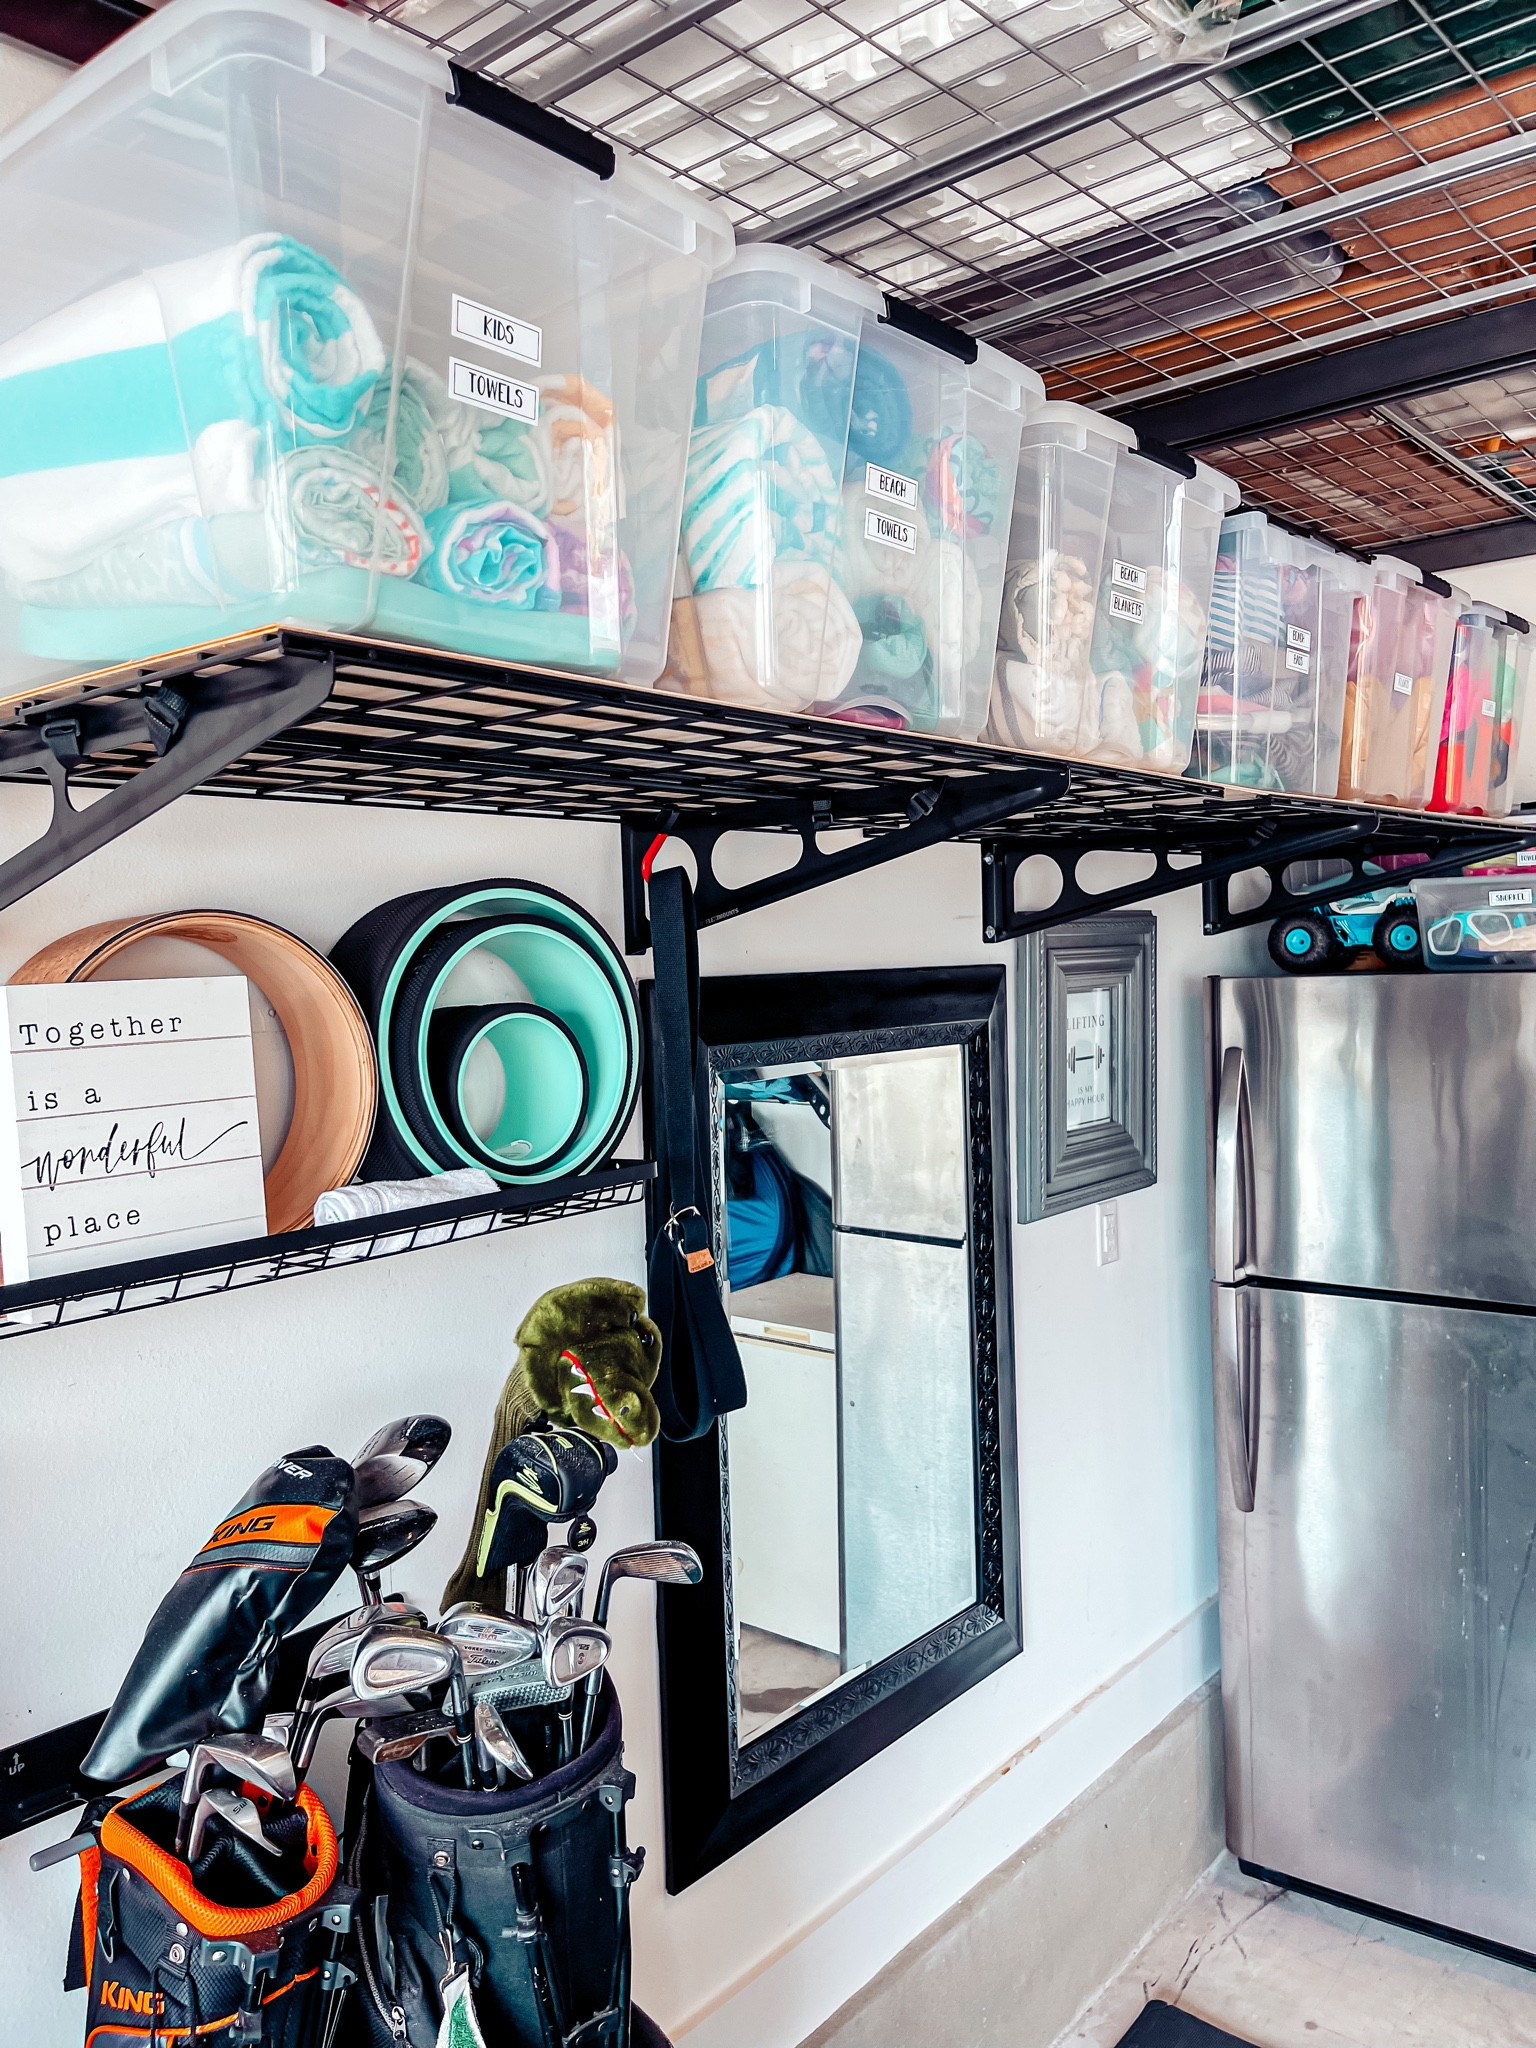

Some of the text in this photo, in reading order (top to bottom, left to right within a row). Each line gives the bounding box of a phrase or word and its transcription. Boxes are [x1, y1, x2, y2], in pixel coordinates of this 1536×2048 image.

[483, 315, 514, 345] KIDS
[468, 371, 523, 409] TOWELS
[879, 474, 907, 498] BEACH
[876, 517, 908, 543] TOWELS
[1120, 566, 1139, 583] BEACH
[1113, 596, 1142, 617] BLANKETS
[1495, 893, 1526, 902] SNORKEL
[19, 1016, 182, 1046] Together
[1066, 1014, 1105, 1031] LIFTING
[28, 1087, 102, 1111] is a
[1066, 1092, 1105, 1109] HAPPY HOUR
[1077, 1084, 1093, 1095] IS MY
[20, 1117, 249, 1191] wonderful
[43, 1208, 141, 1247] place
[9, 1762, 25, 1776] UP
